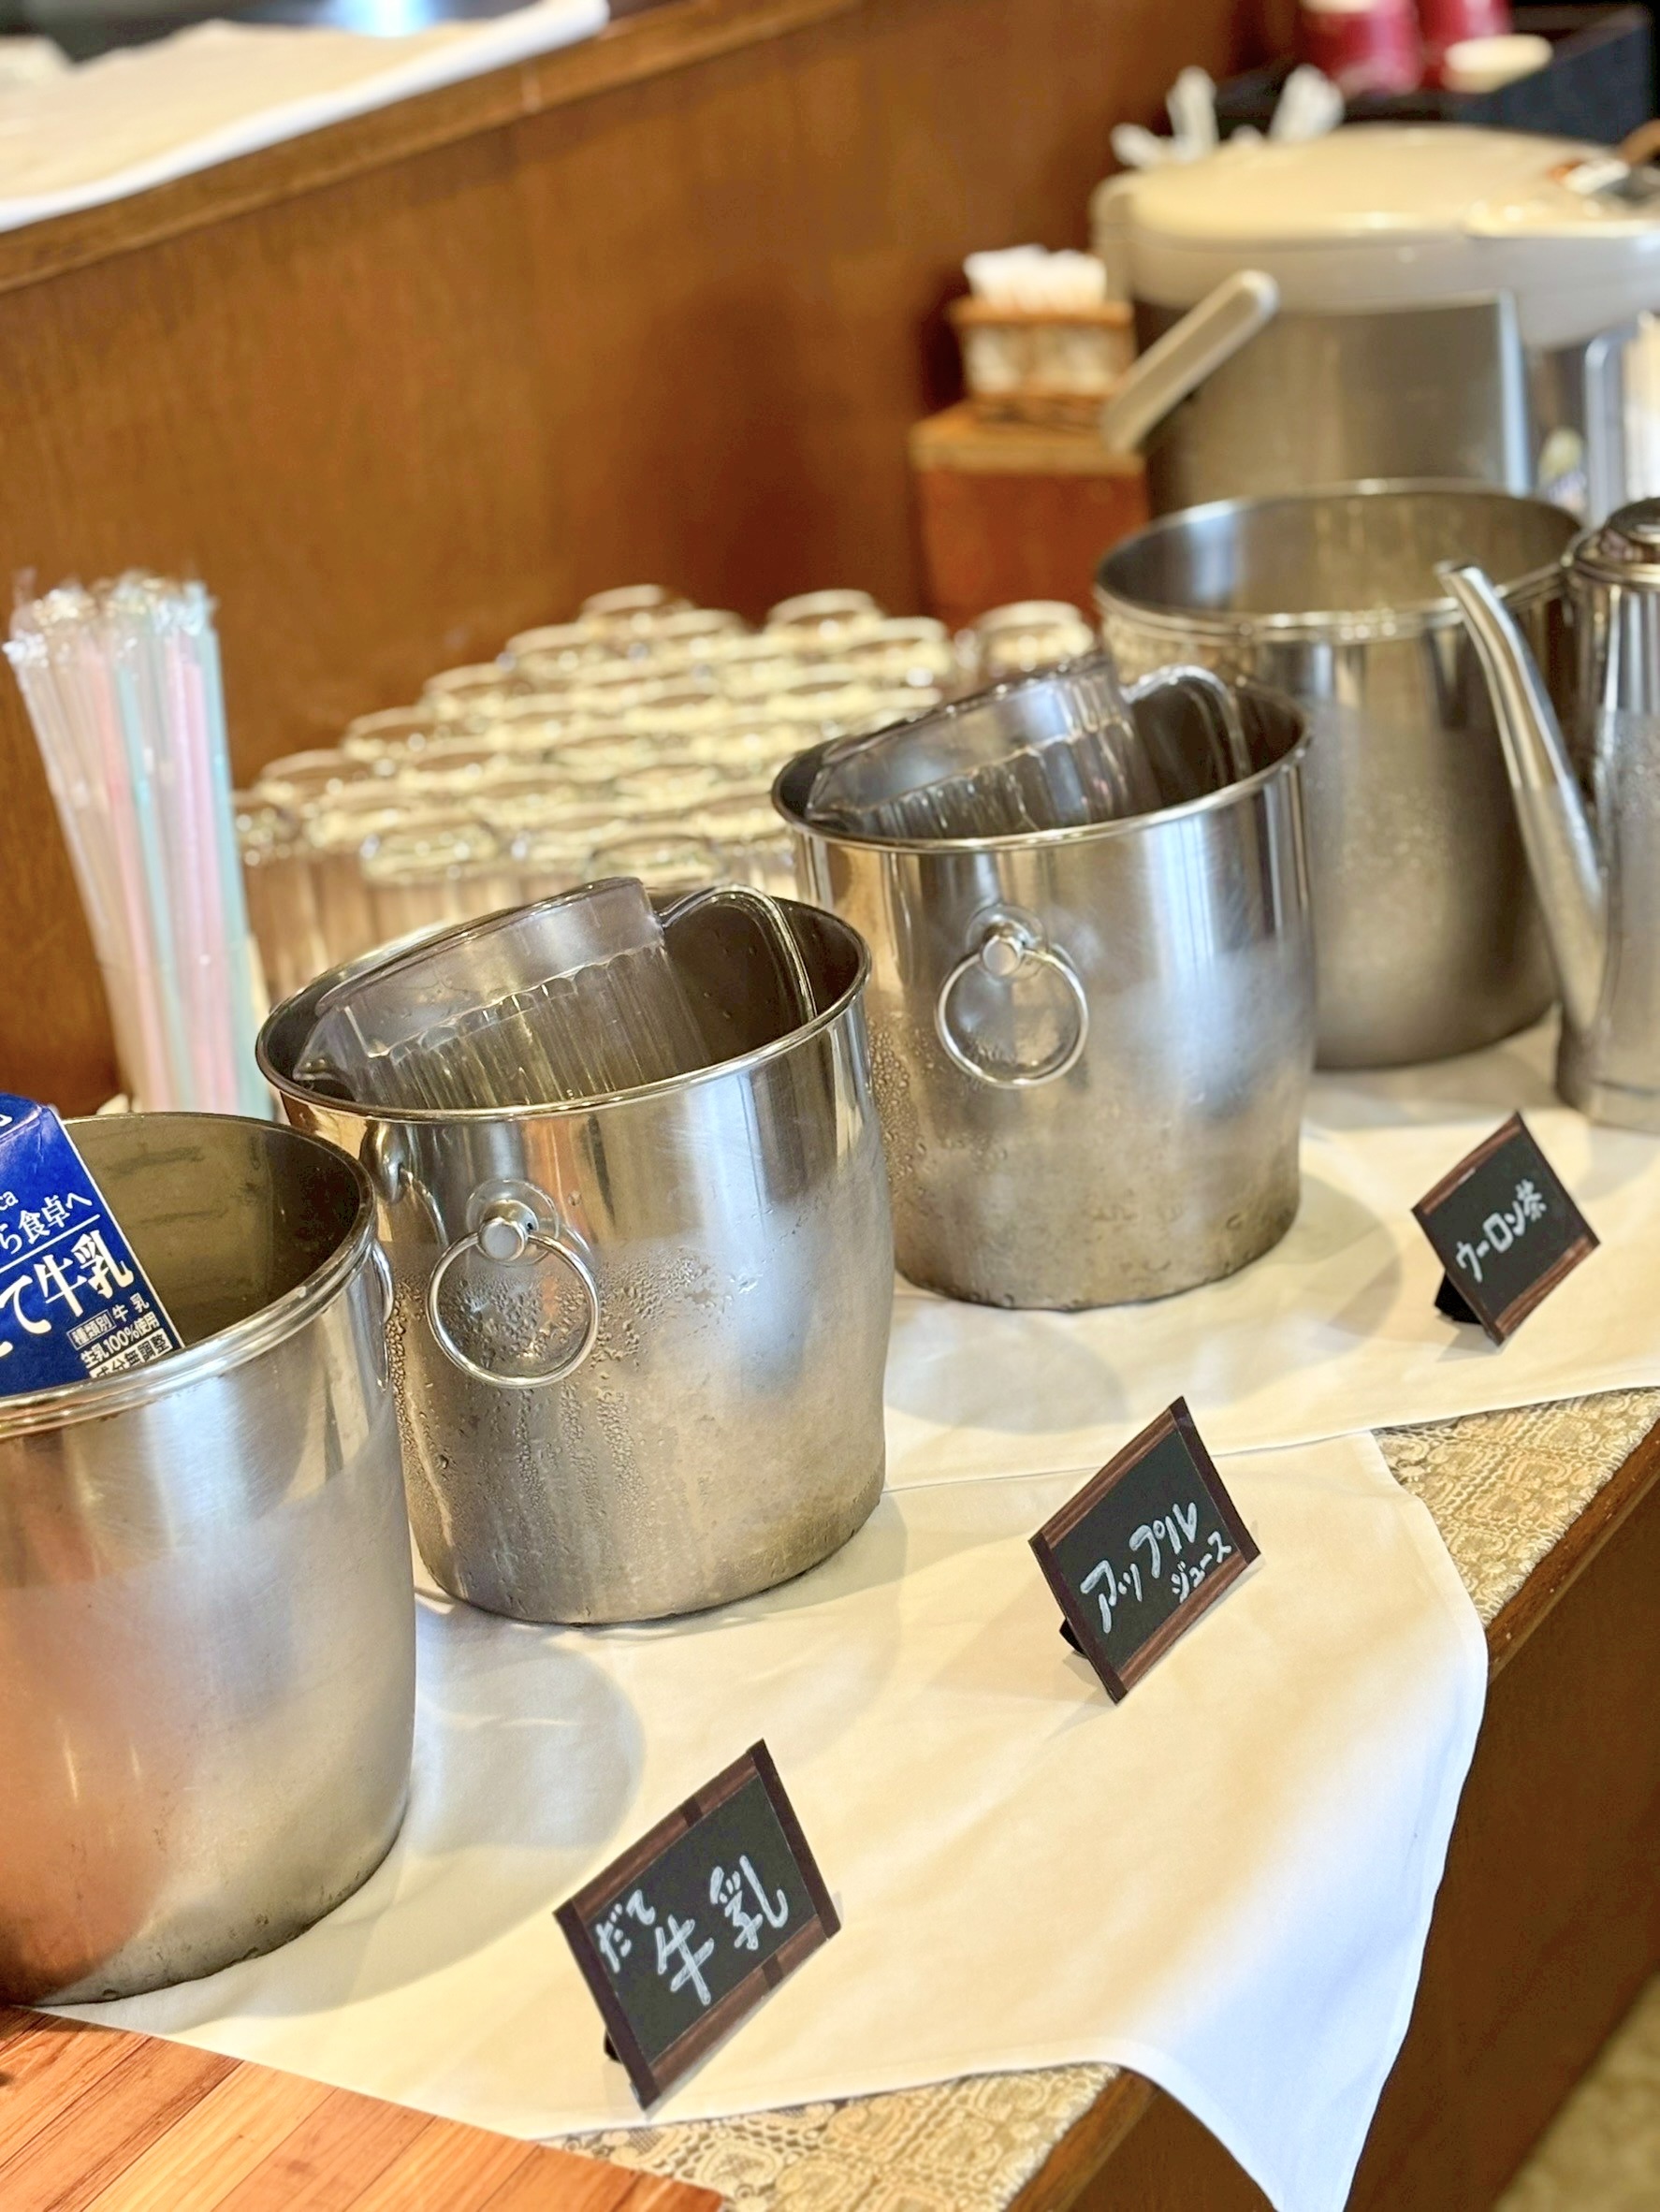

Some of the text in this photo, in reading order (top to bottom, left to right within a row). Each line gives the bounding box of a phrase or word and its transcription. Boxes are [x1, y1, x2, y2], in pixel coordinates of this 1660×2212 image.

[0, 1192, 93, 1255] ら食卓へ
[1456, 1179, 1547, 1283] ウーロン茶
[0, 1230, 134, 1357] て牛乳
[1172, 1531, 1232, 1604] ジュース
